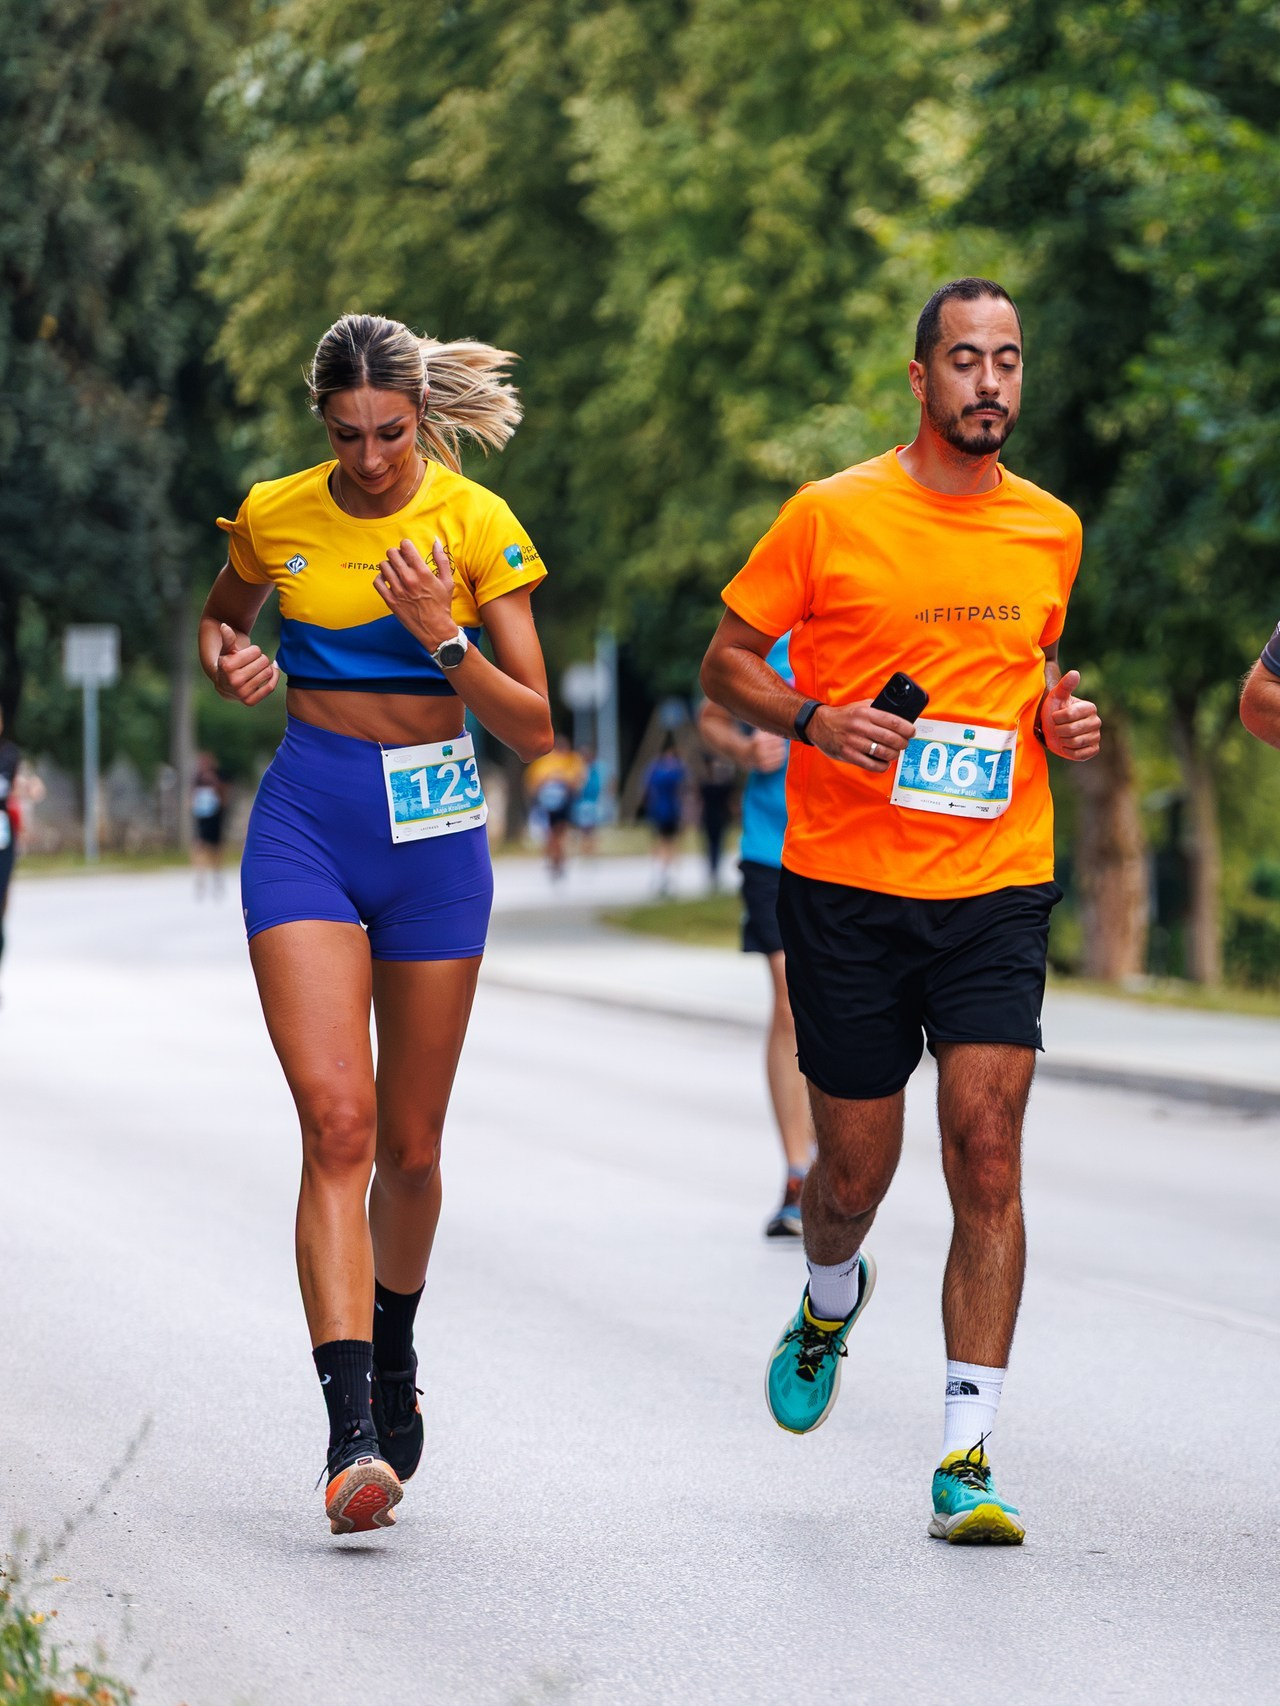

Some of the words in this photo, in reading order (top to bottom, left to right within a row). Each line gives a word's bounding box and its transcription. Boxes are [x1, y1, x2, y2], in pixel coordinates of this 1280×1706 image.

[347, 561, 381, 571] FITPAS
[933, 605, 1021, 623] FITPASS
[410, 757, 481, 810] 123
[919, 741, 1002, 792] 061
